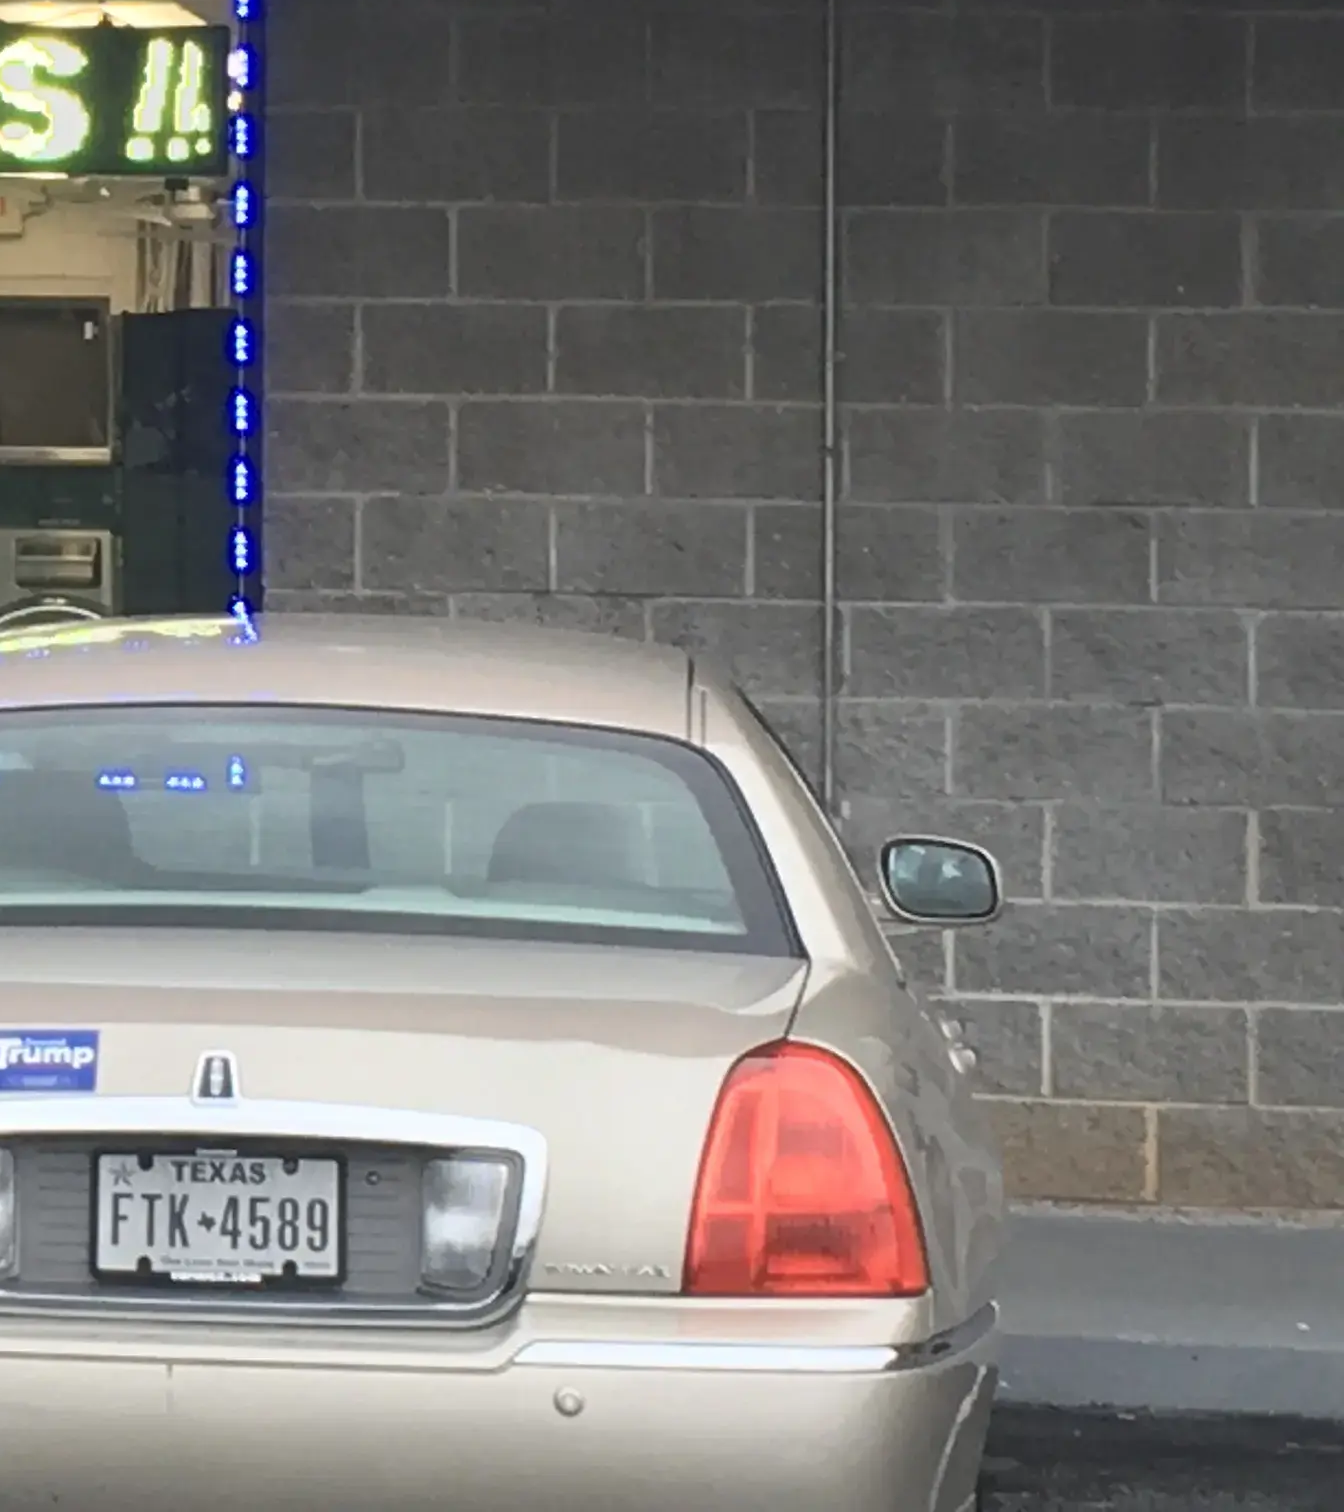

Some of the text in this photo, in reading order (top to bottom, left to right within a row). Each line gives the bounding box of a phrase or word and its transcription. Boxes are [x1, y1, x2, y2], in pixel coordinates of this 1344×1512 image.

[170, 1161, 266, 1184] TEXAS
[111, 1193, 329, 1252] FTK 4589
